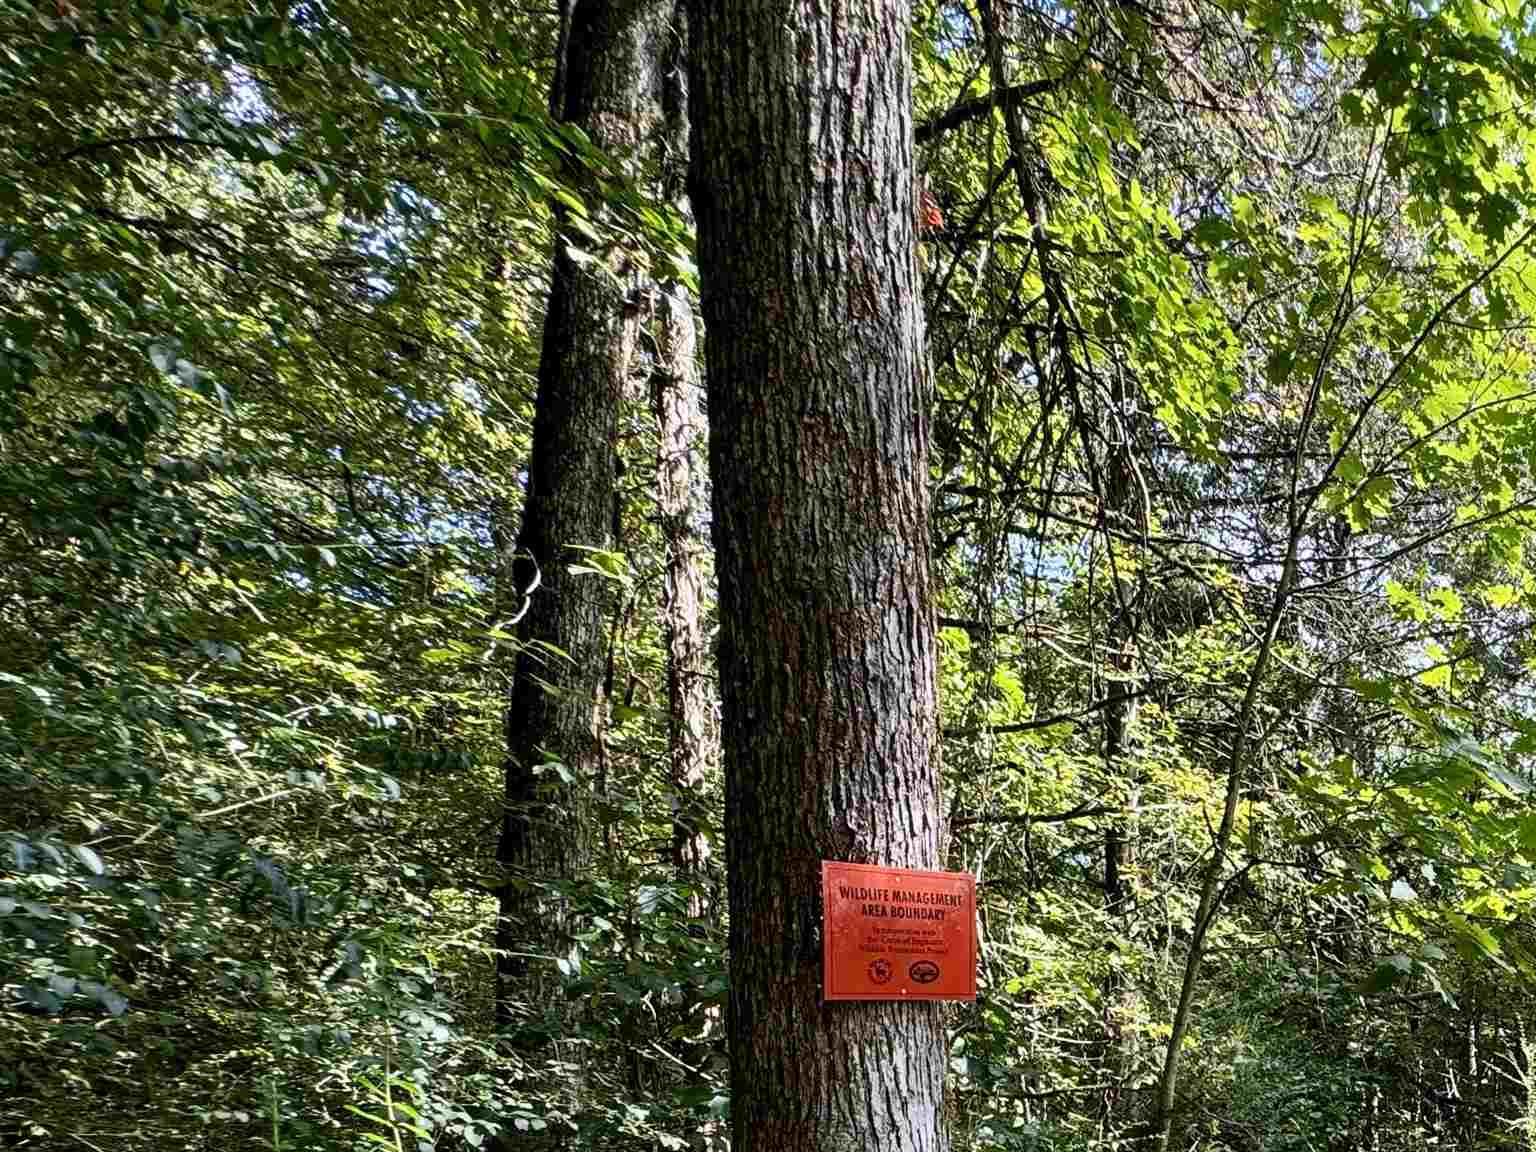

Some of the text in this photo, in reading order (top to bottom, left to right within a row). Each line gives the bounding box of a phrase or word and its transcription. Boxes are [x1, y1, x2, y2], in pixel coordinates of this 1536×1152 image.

[839, 885, 962, 907] WILDLIFE MANAGEMENT
[862, 905, 945, 921] AREA BOUNDARY
